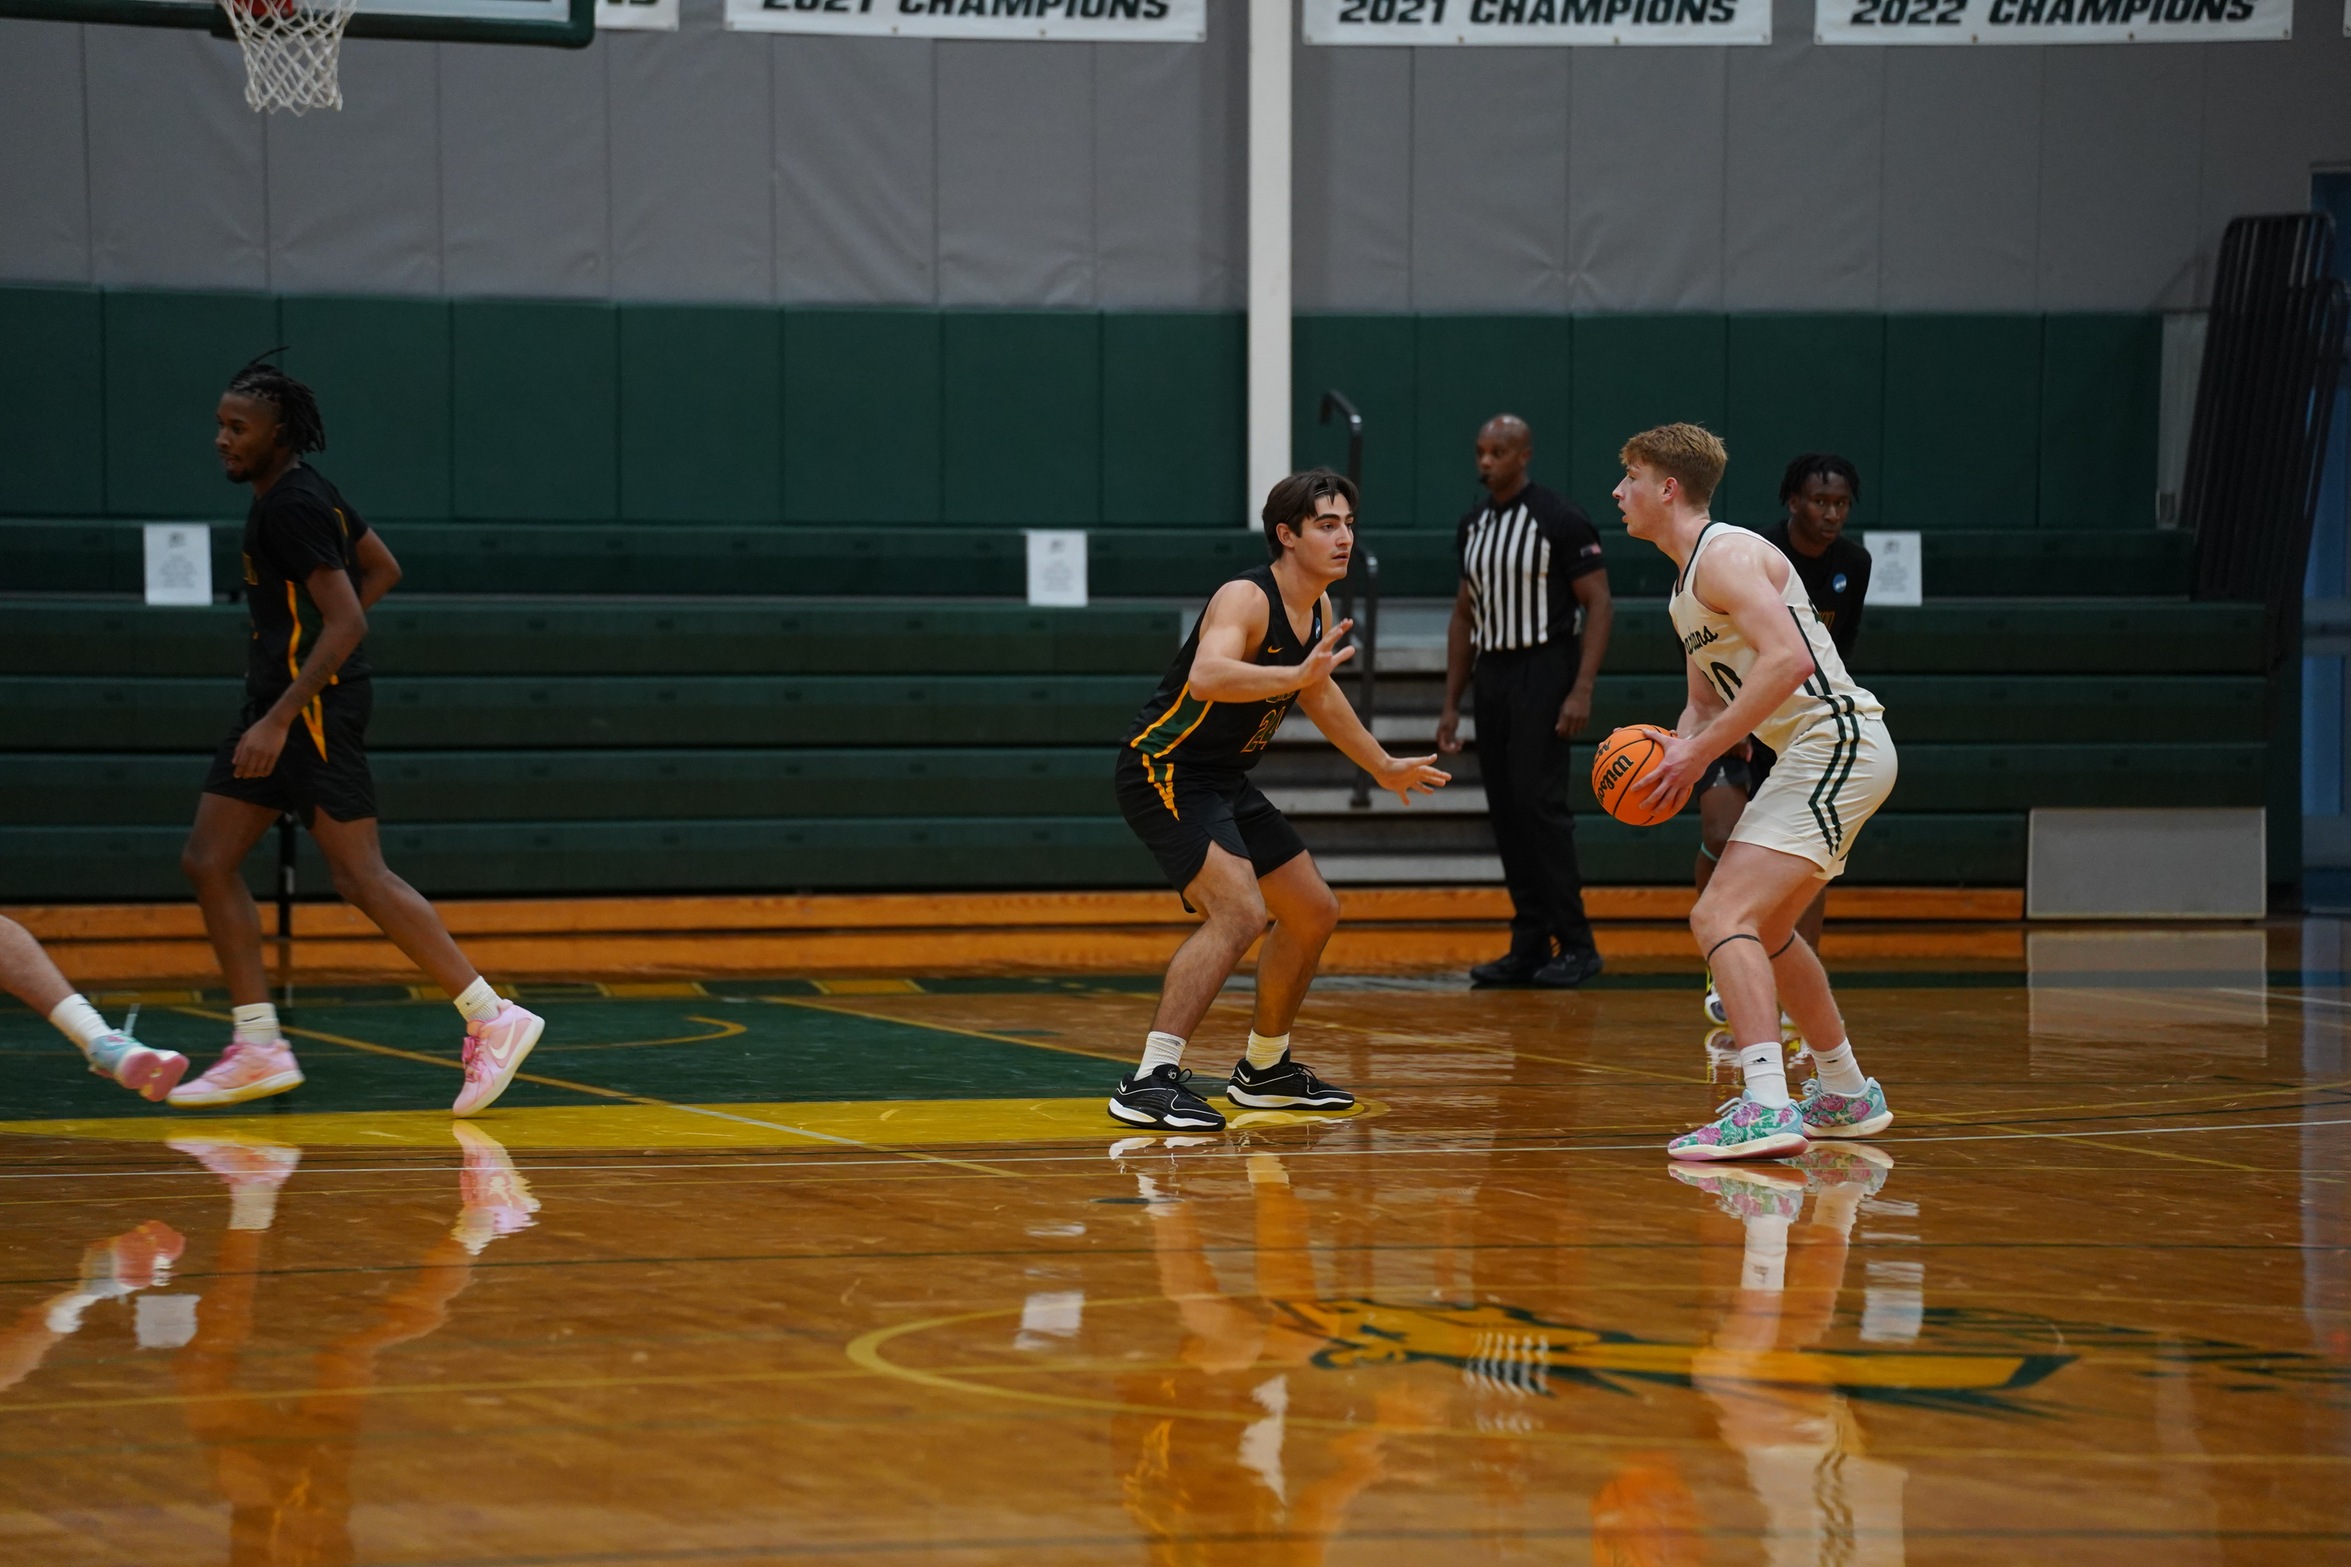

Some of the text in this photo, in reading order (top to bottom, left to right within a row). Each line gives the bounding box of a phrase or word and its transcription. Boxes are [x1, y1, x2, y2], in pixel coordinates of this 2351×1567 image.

[898, 0, 1169, 19] CHAMPIONS
[1339, 0, 1734, 24] 2021 CHAMPIONS
[1850, 0, 2256, 25] 2022 CHAMPIONS
